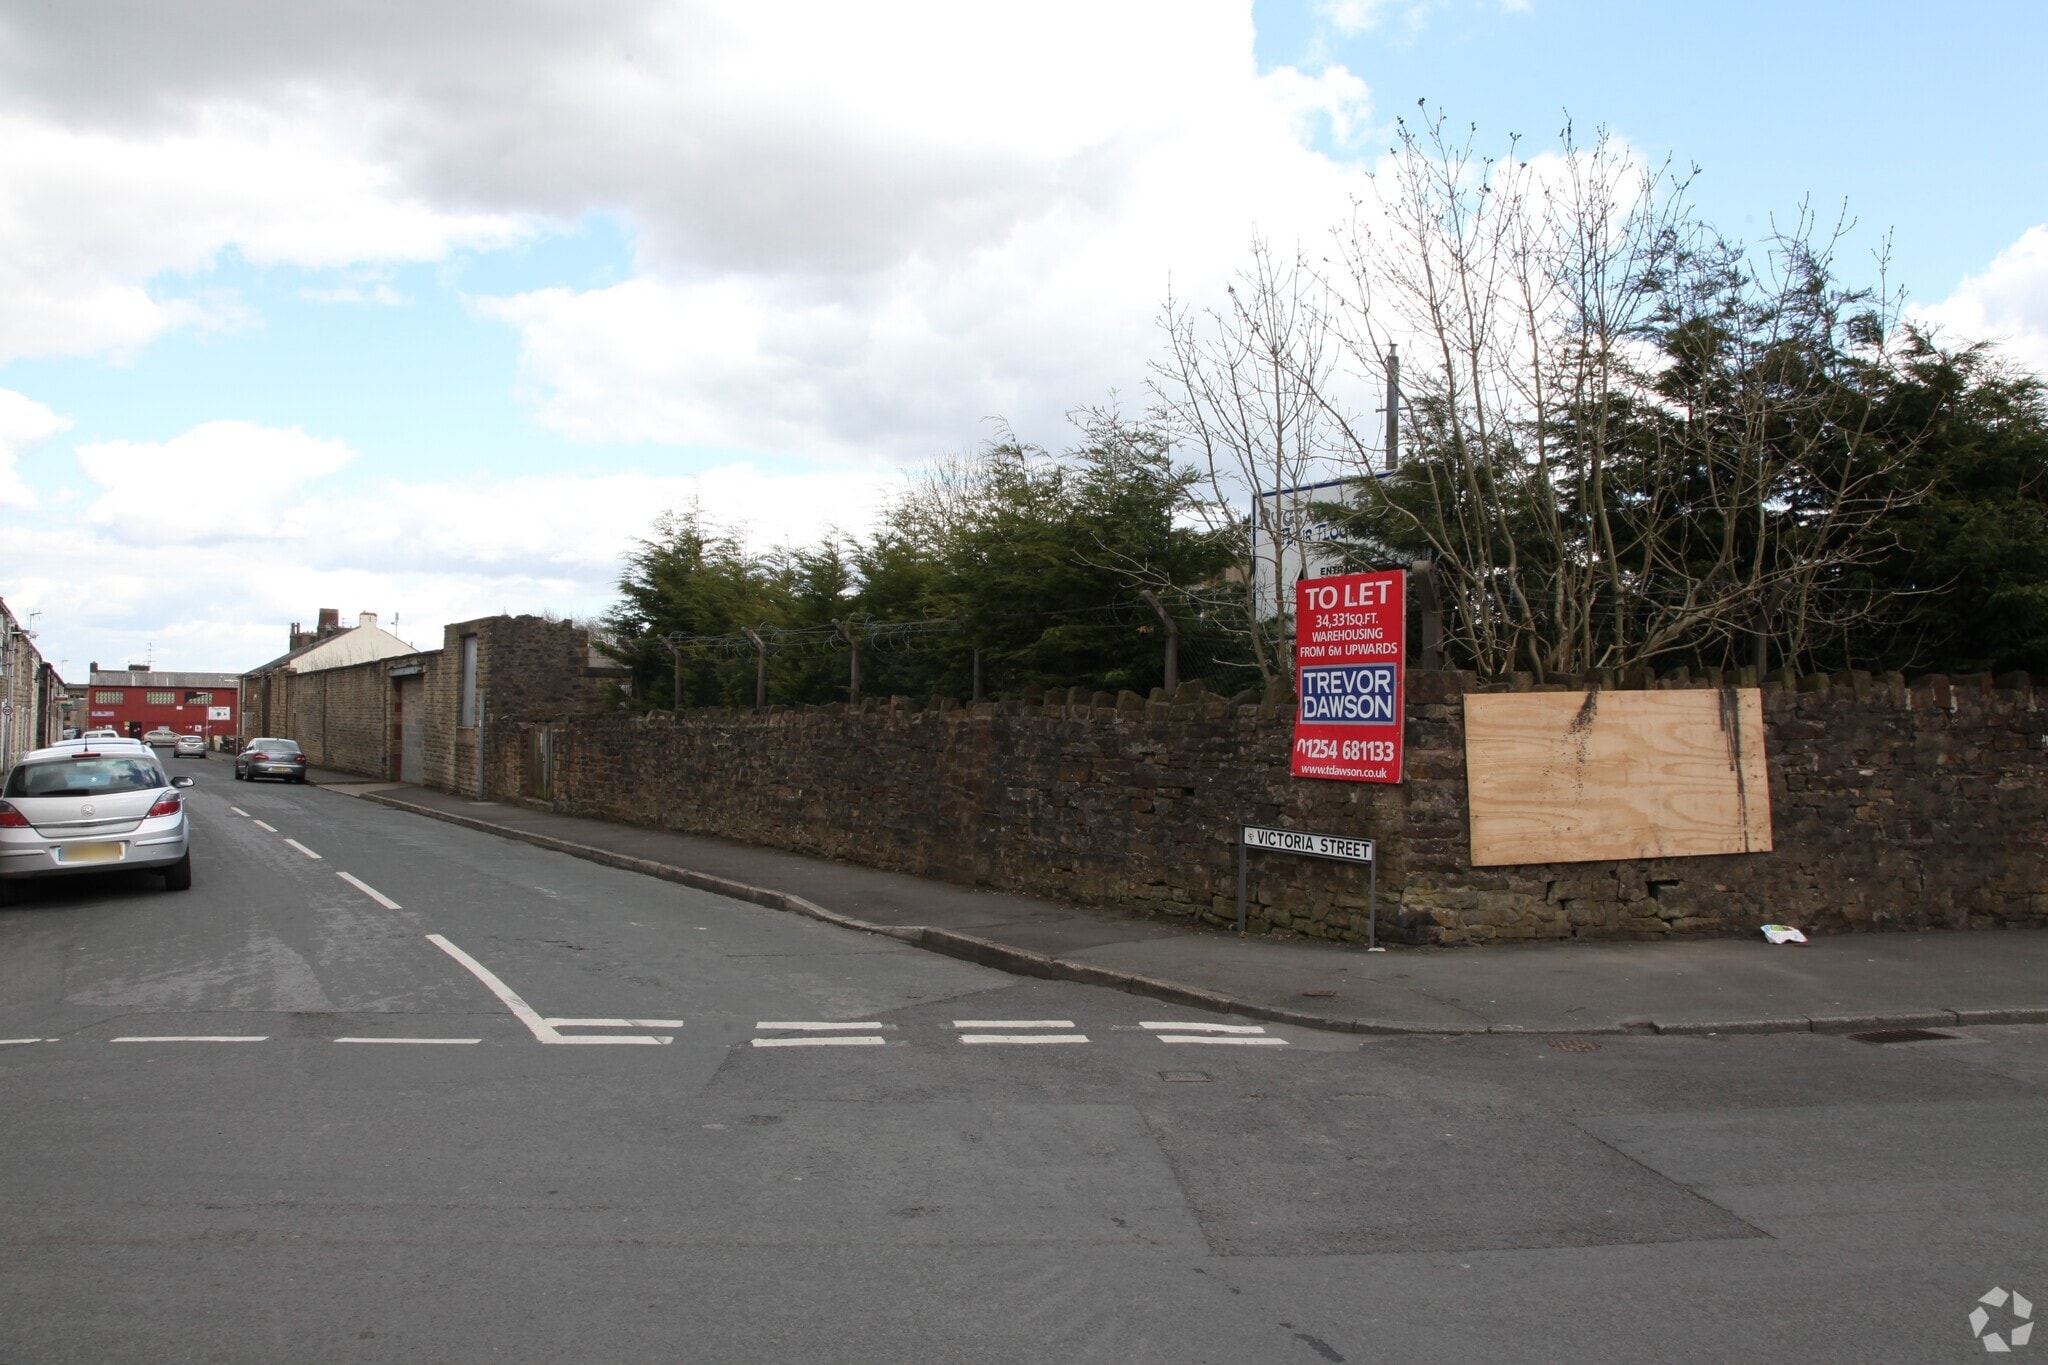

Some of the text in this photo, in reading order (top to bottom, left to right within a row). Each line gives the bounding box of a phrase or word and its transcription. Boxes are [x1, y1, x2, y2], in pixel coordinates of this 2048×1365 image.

[1305, 580, 1393, 610] TO LET
[1312, 627, 1383, 643] WAREHOUSING
[1300, 646, 1325, 658] FROM
[1345, 642, 1398, 656] UPWARDS
[1303, 669, 1391, 694] TREVOR
[1303, 695, 1392, 719] DAWSON
[1297, 738, 1395, 762] 01254 681133
[1301, 765, 1387, 779] www.tdawson.co.uk
[1257, 830, 1370, 858] VICTORIA STREET
